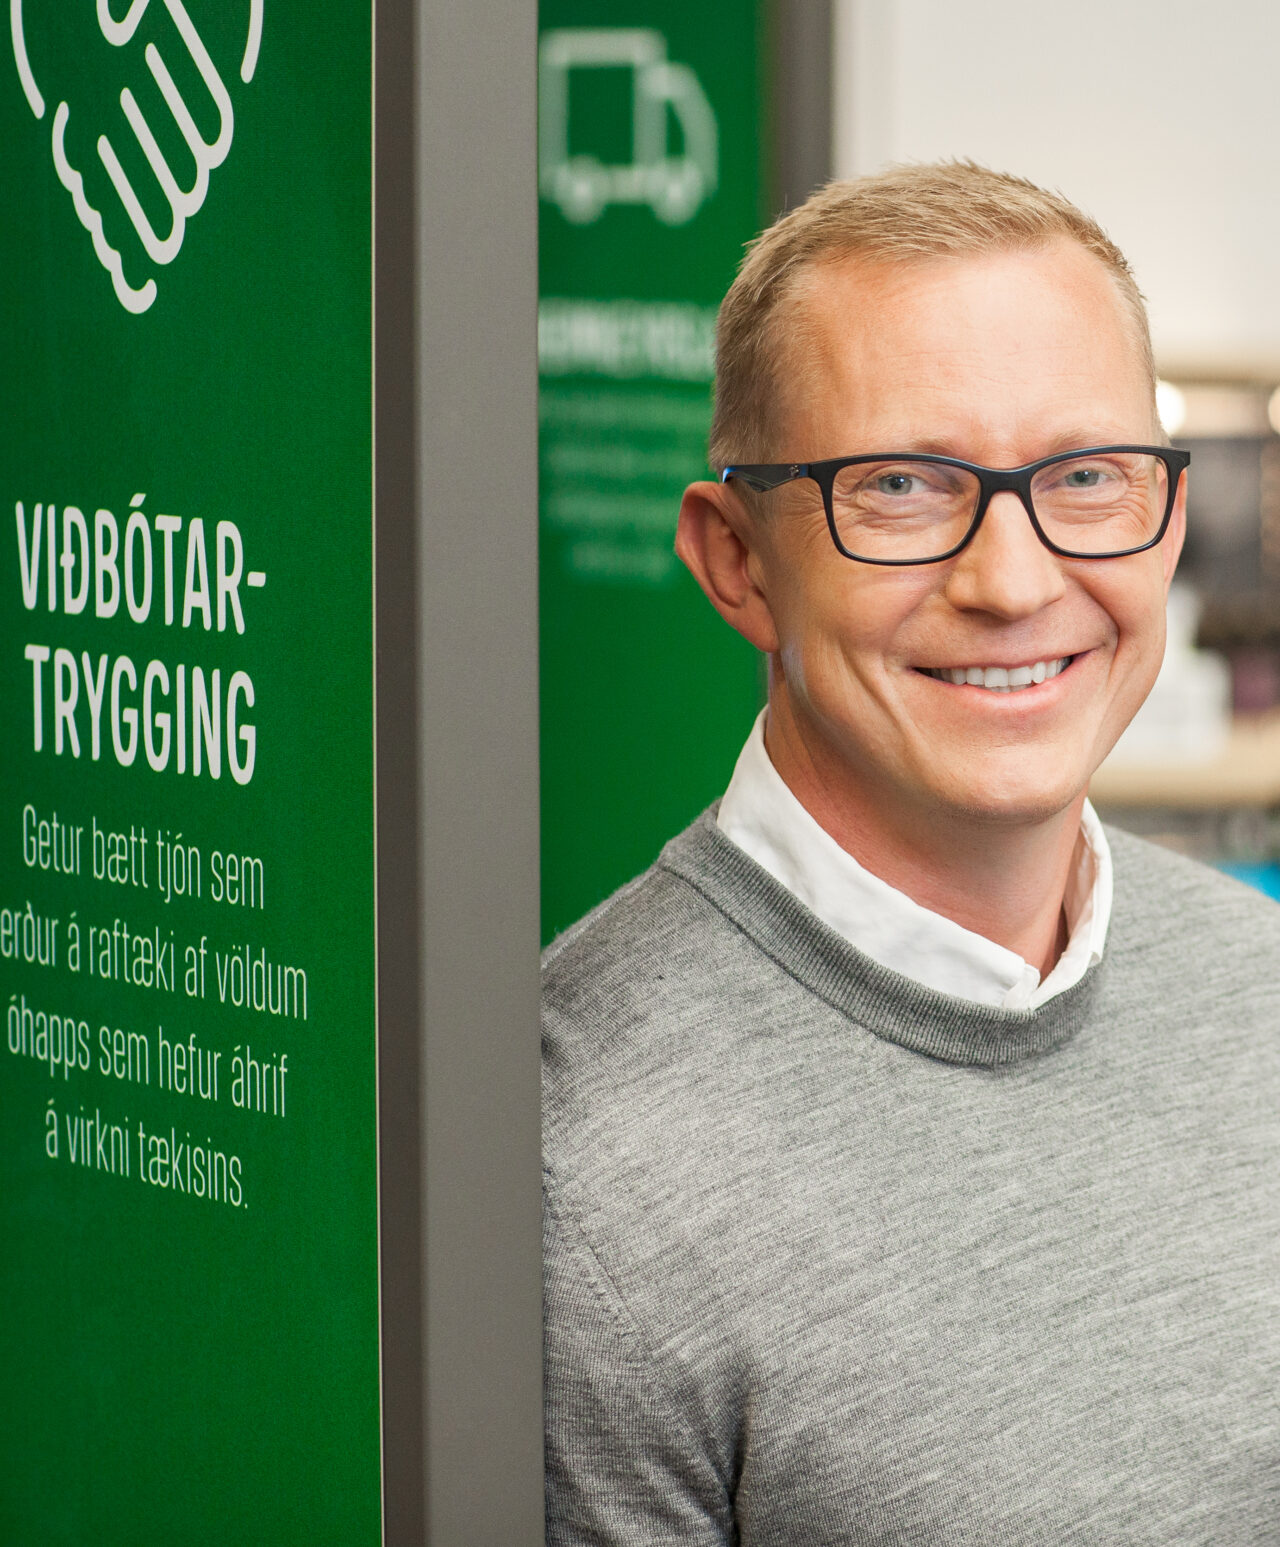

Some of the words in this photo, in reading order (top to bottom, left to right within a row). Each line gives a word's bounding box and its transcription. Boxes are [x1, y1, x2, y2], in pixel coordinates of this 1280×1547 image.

[16, 493, 266, 635] VIÐBÓTAR-
[25, 644, 256, 785] TRYGGING
[23, 804, 83, 876] Getur
[92, 816, 148, 888] bætt
[157, 829, 201, 904] tjón
[211, 850, 264, 910] sem
[0, 900, 58, 967] erður
[68, 912, 80, 972] á
[89, 918, 175, 992] raftæki
[185, 936, 208, 999] af
[216, 945, 307, 1020] völdum
[8, 995, 90, 1081] óhapps
[99, 1026, 149, 1085] sem
[159, 1026, 222, 1102] hefur
[231, 1045, 289, 1118] áhrif
[46, 1098, 58, 1158] á
[66, 1106, 129, 1177] virkni
[138, 1122, 248, 1209] tækisins.
